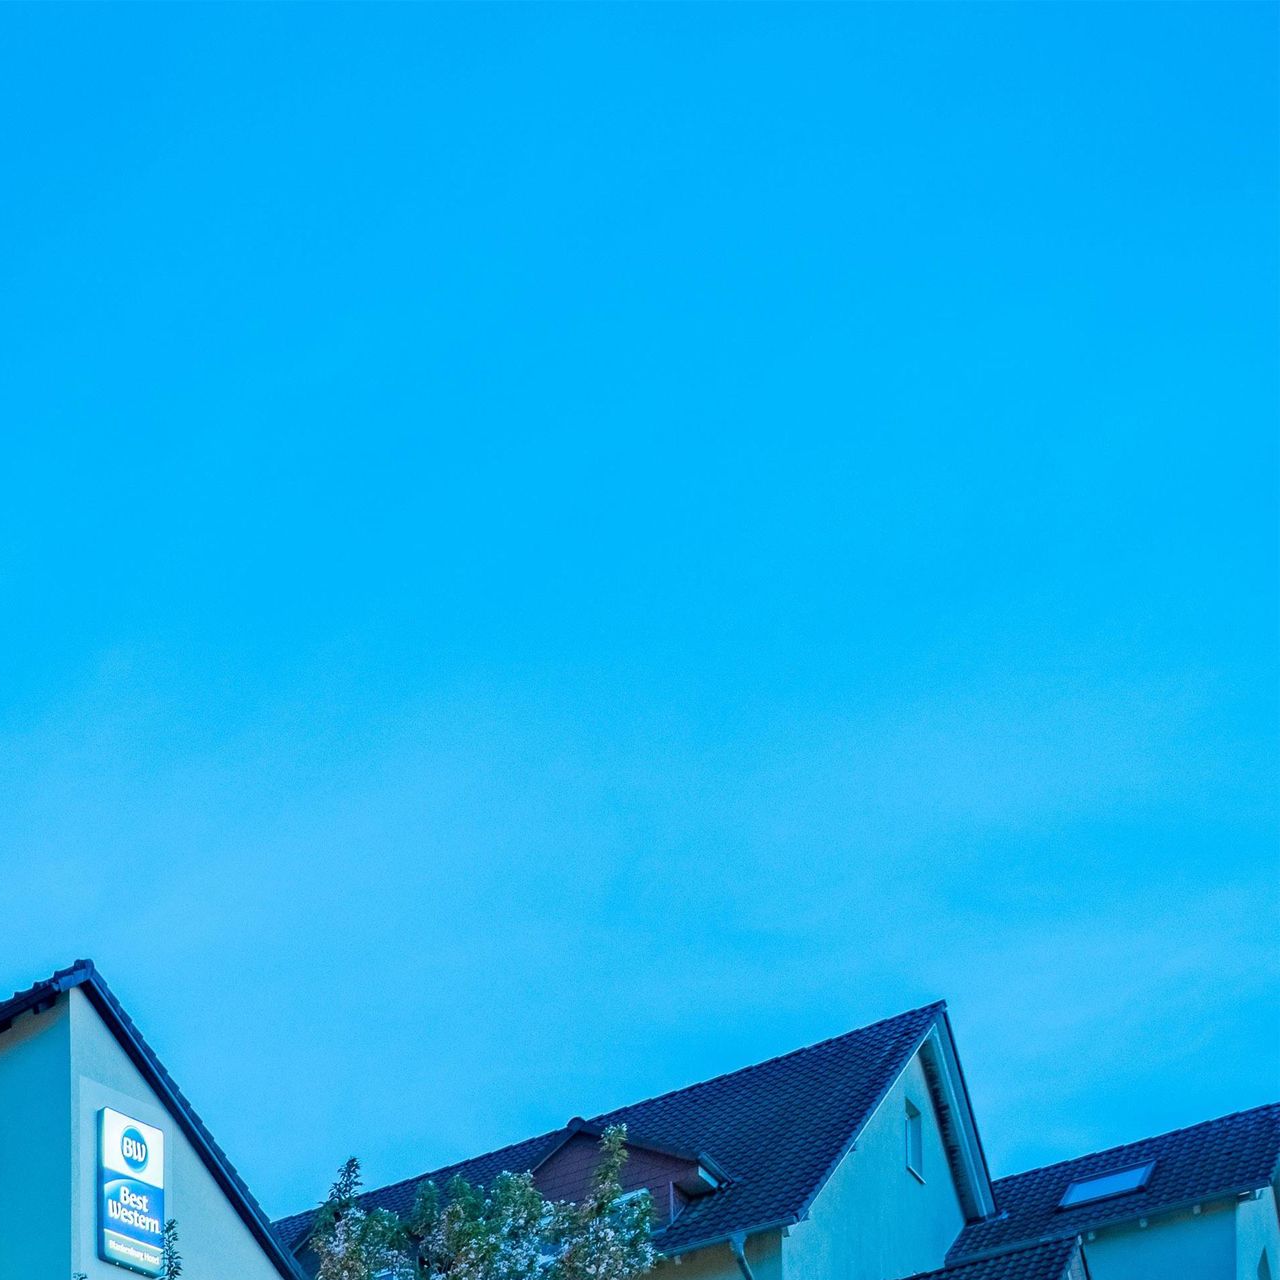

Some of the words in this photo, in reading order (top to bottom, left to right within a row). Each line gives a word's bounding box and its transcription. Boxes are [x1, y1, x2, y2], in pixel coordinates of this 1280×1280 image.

[122, 1135, 148, 1162] BW
[120, 1185, 149, 1213] Best
[108, 1198, 161, 1234] Western
